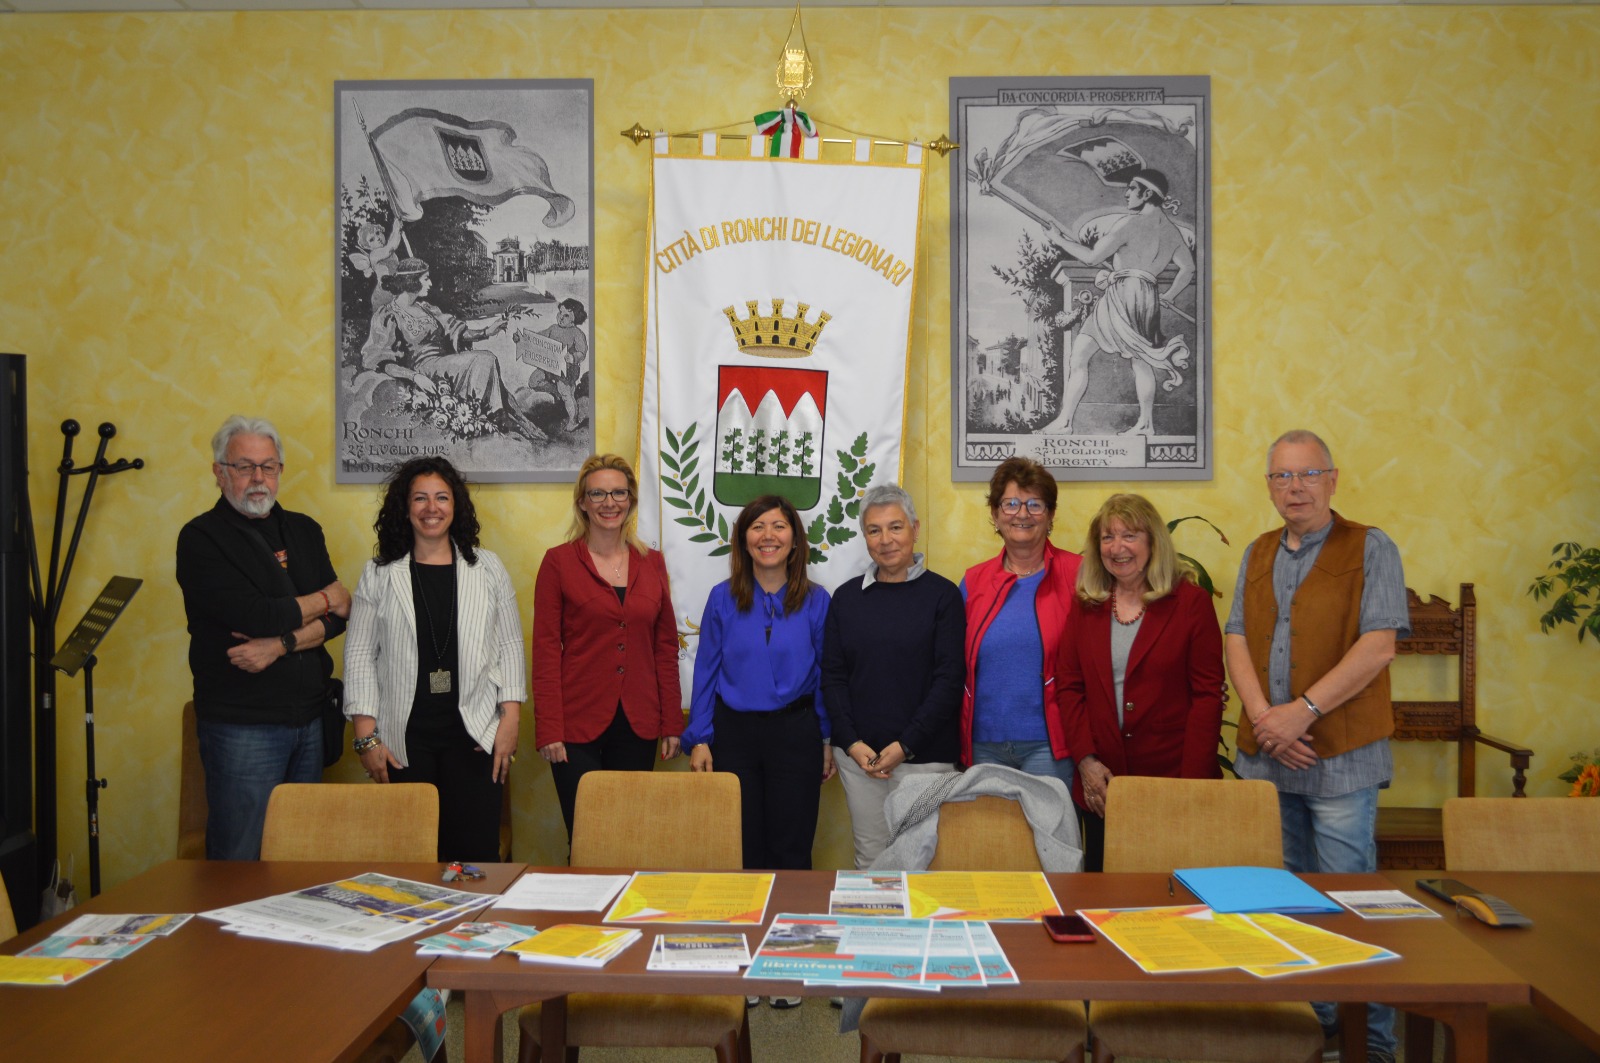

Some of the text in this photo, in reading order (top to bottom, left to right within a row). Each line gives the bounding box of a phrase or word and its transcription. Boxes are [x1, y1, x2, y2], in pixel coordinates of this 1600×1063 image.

[1001, 92, 1017, 104] DA
[1018, 91, 1086, 103] CONCORDIA
[656, 217, 912, 287] CITTÀ DI RONCHI DEI LEGIONARI
[343, 421, 414, 443] RONCHI
[1042, 438, 1110, 448] RONCHI
[423, 445, 448, 457] 1912
[1053, 448, 1102, 456] LUGLIO
[1104, 448, 1127, 457] 1912
[1042, 457, 1110, 466] BORGATA
